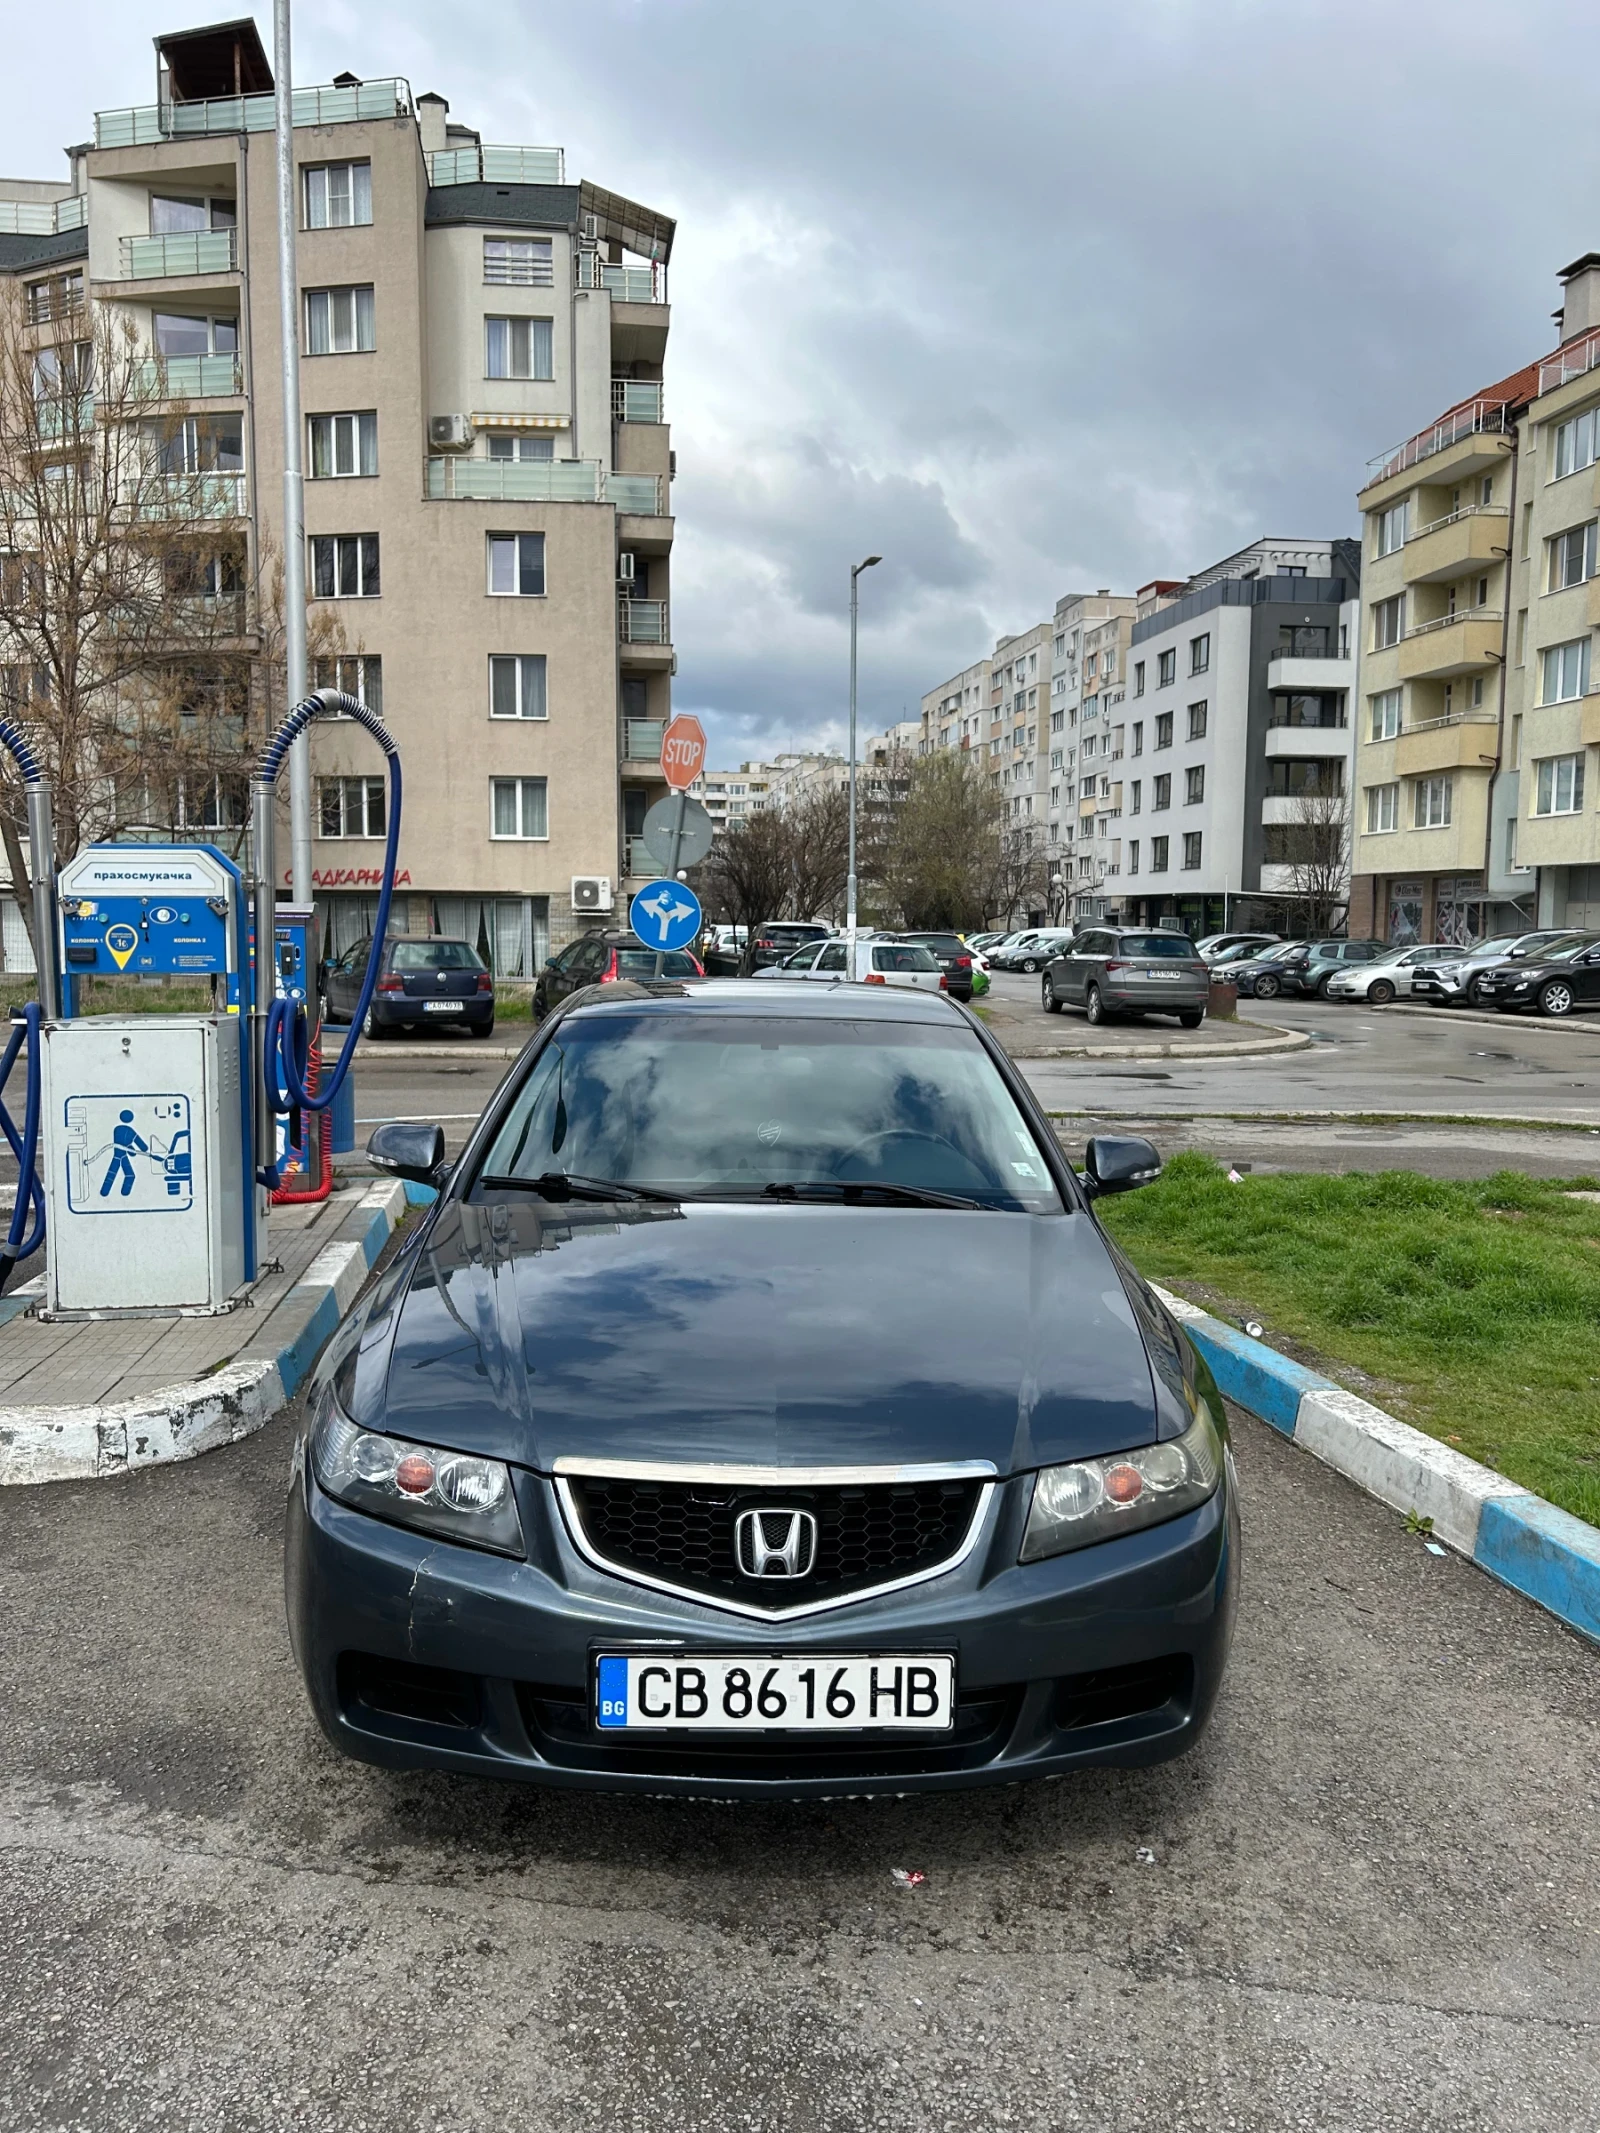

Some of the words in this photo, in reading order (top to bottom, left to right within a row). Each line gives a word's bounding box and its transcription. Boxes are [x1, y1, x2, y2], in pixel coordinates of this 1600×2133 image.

[665, 738, 701, 767] STOP
[94, 872, 192, 881] прахосмукачка
[284, 869, 411, 888] САДКАРНИА
[638, 1667, 708, 1718] CB
[722, 1667, 855, 1719] 8616
[869, 1666, 939, 1718] HB
[603, 1701, 625, 1716] BG
